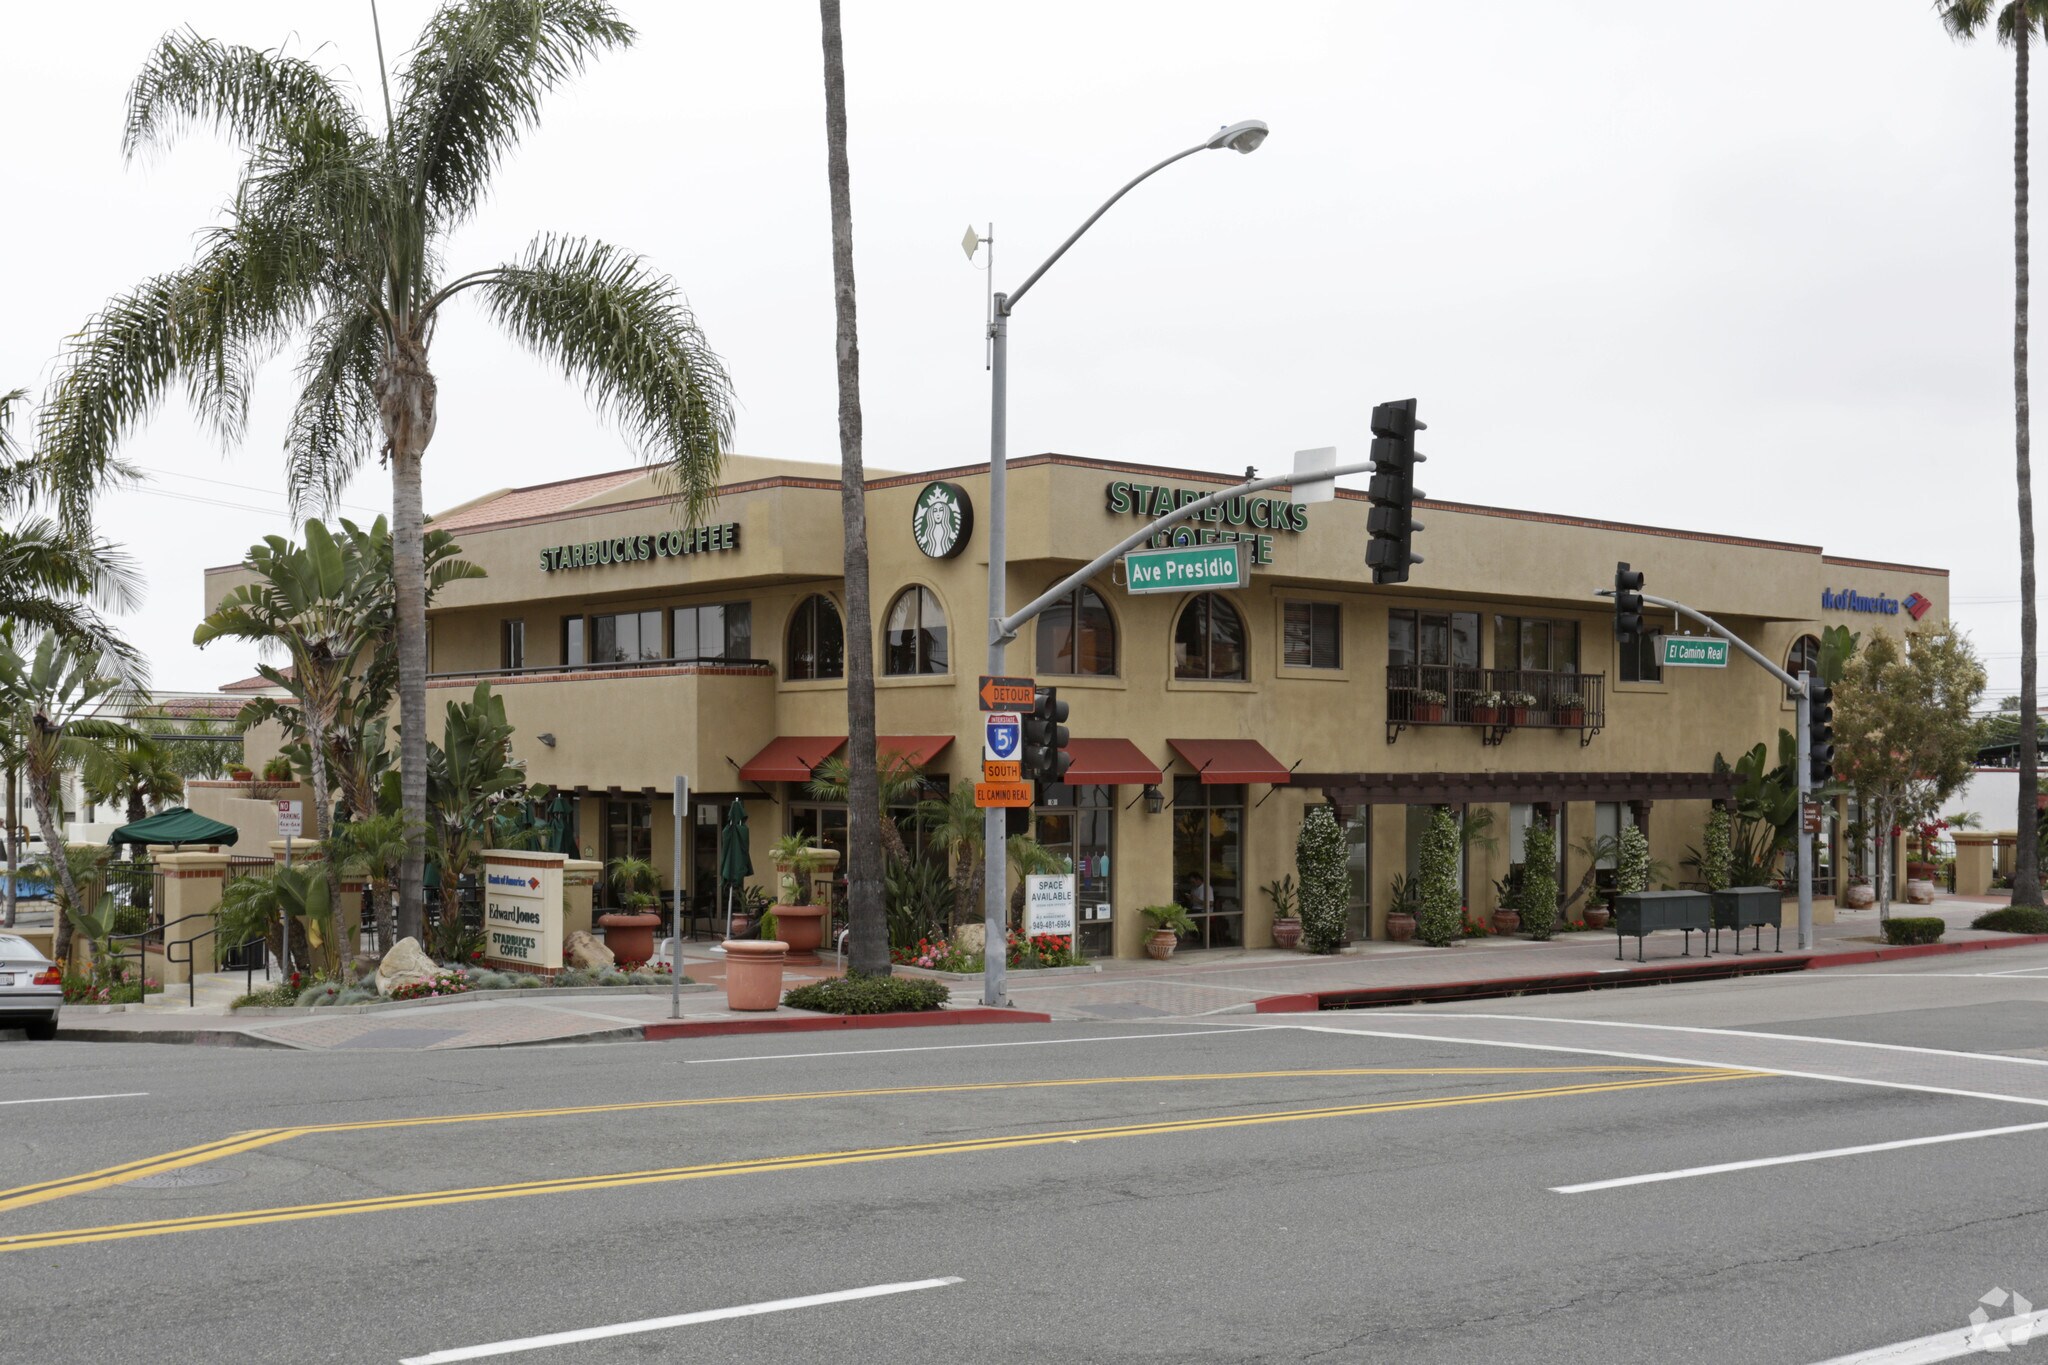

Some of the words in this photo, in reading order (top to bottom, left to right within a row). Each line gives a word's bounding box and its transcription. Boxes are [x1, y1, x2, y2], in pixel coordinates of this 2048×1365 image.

[1109, 480, 1309, 532] STARBUCKS
[539, 534, 651, 571] STARBUCKS
[655, 522, 735, 557] COFFEE
[1132, 563, 1161, 582] Ave
[1165, 557, 1234, 580] Presidio
[1835, 588, 1849, 609] of
[1849, 589, 1899, 615] America
[1669, 644, 1678, 658] El
[1679, 645, 1705, 659] Camino
[1707, 646, 1723, 660] Real
[993, 687, 1031, 701] DETOUR
[997, 728, 1009, 750] 5
[988, 765, 1018, 777] SOUTH
[978, 790, 984, 801] EL
[986, 789, 1011, 801] CAMINO
[1012, 790, 1028, 801] REAL
[280, 802, 288, 811] NO
[488, 874, 500, 885] Bank
[506, 875, 526, 887] America
[1038, 881, 1062, 890] SPACE
[1032, 892, 1072, 902] AVAILABLE
[489, 903, 516, 921] Edward
[516, 906, 540, 924] Jones
[492, 932, 536, 949] STARBUCKS
[500, 944, 528, 959] COFFEE
